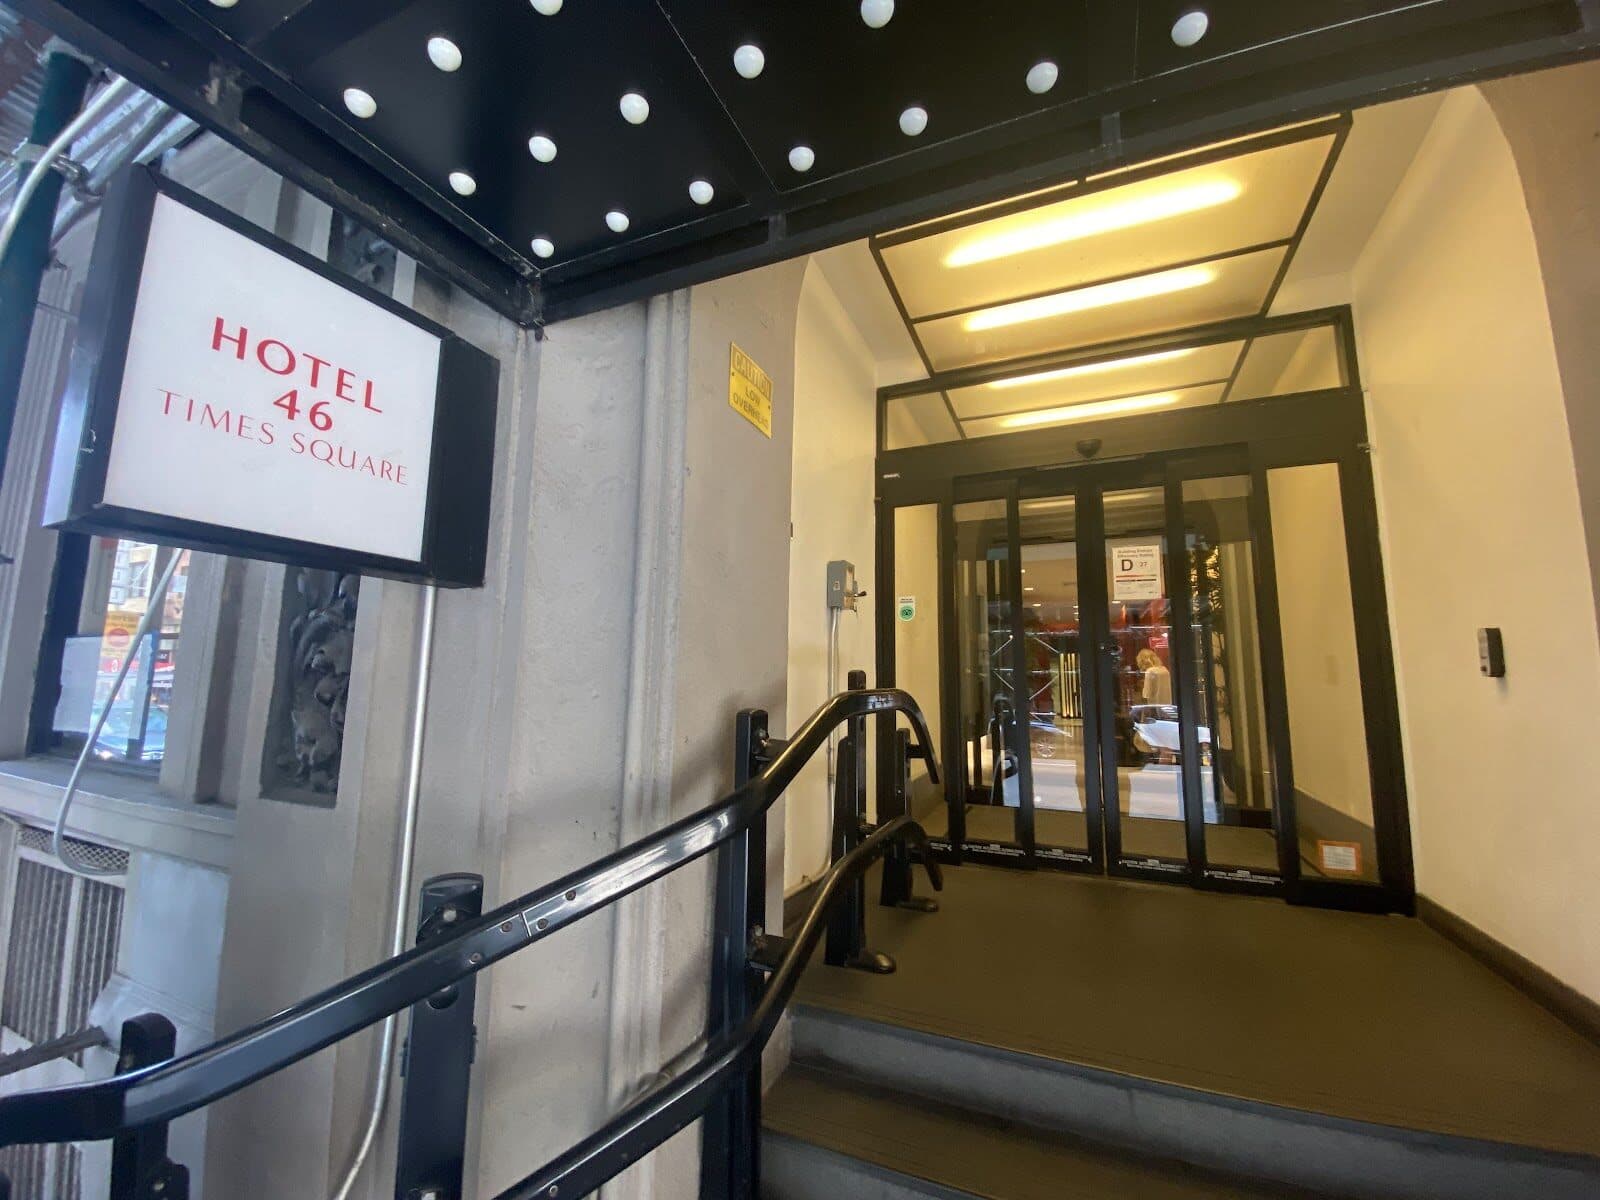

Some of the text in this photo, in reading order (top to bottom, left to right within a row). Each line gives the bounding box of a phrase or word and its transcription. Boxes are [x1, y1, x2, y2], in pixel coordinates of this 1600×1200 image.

[212, 316, 383, 414] HOTEL
[273, 389, 333, 432] 46
[745, 386, 761, 407] LOW
[156, 387, 409, 486] TIMES SQUARE
[1121, 559, 1134, 571] D
